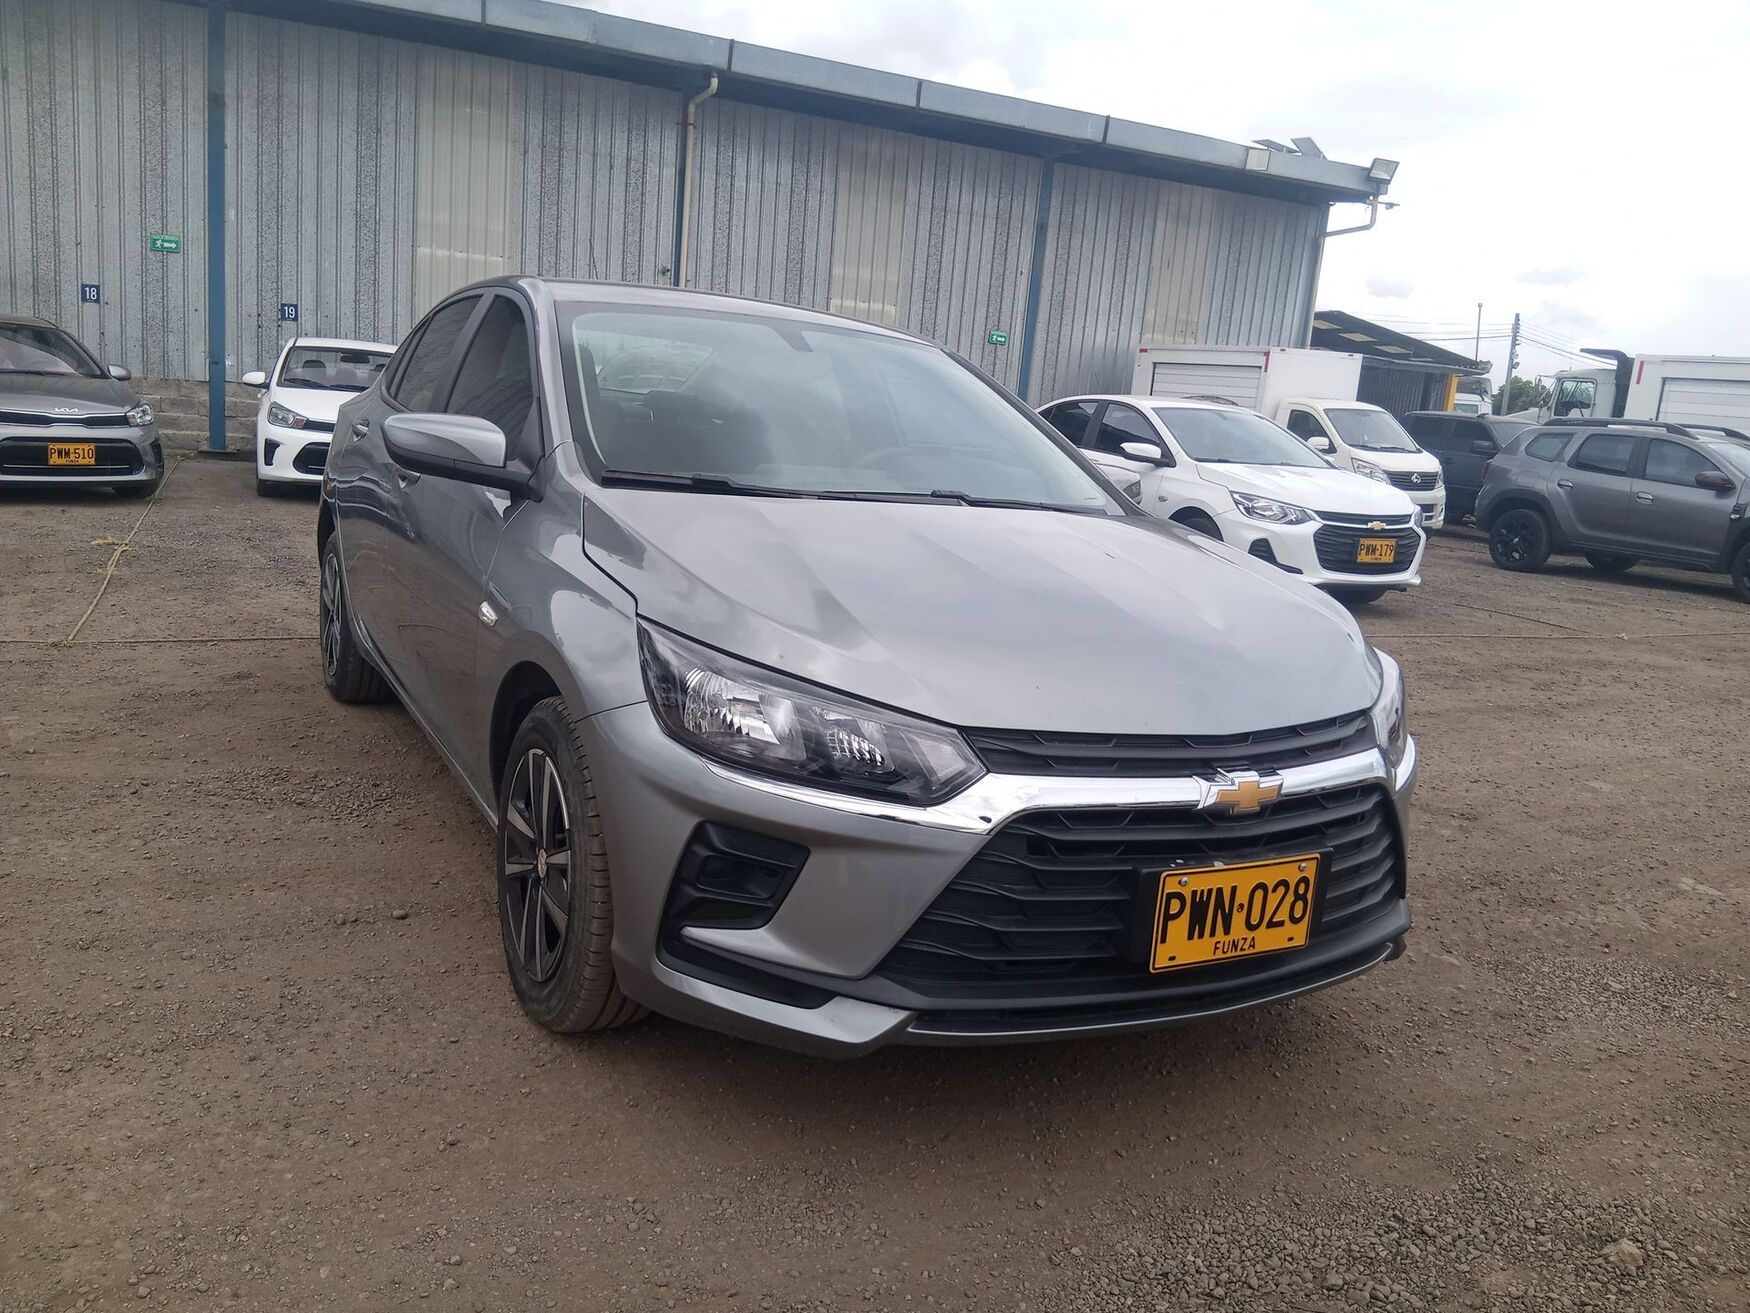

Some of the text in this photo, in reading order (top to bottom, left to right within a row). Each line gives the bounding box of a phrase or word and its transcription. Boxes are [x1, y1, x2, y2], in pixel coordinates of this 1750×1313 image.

[85, 287, 97, 300] 18
[284, 306, 295, 318] 19
[1213, 936, 1256, 956] FUNZA
